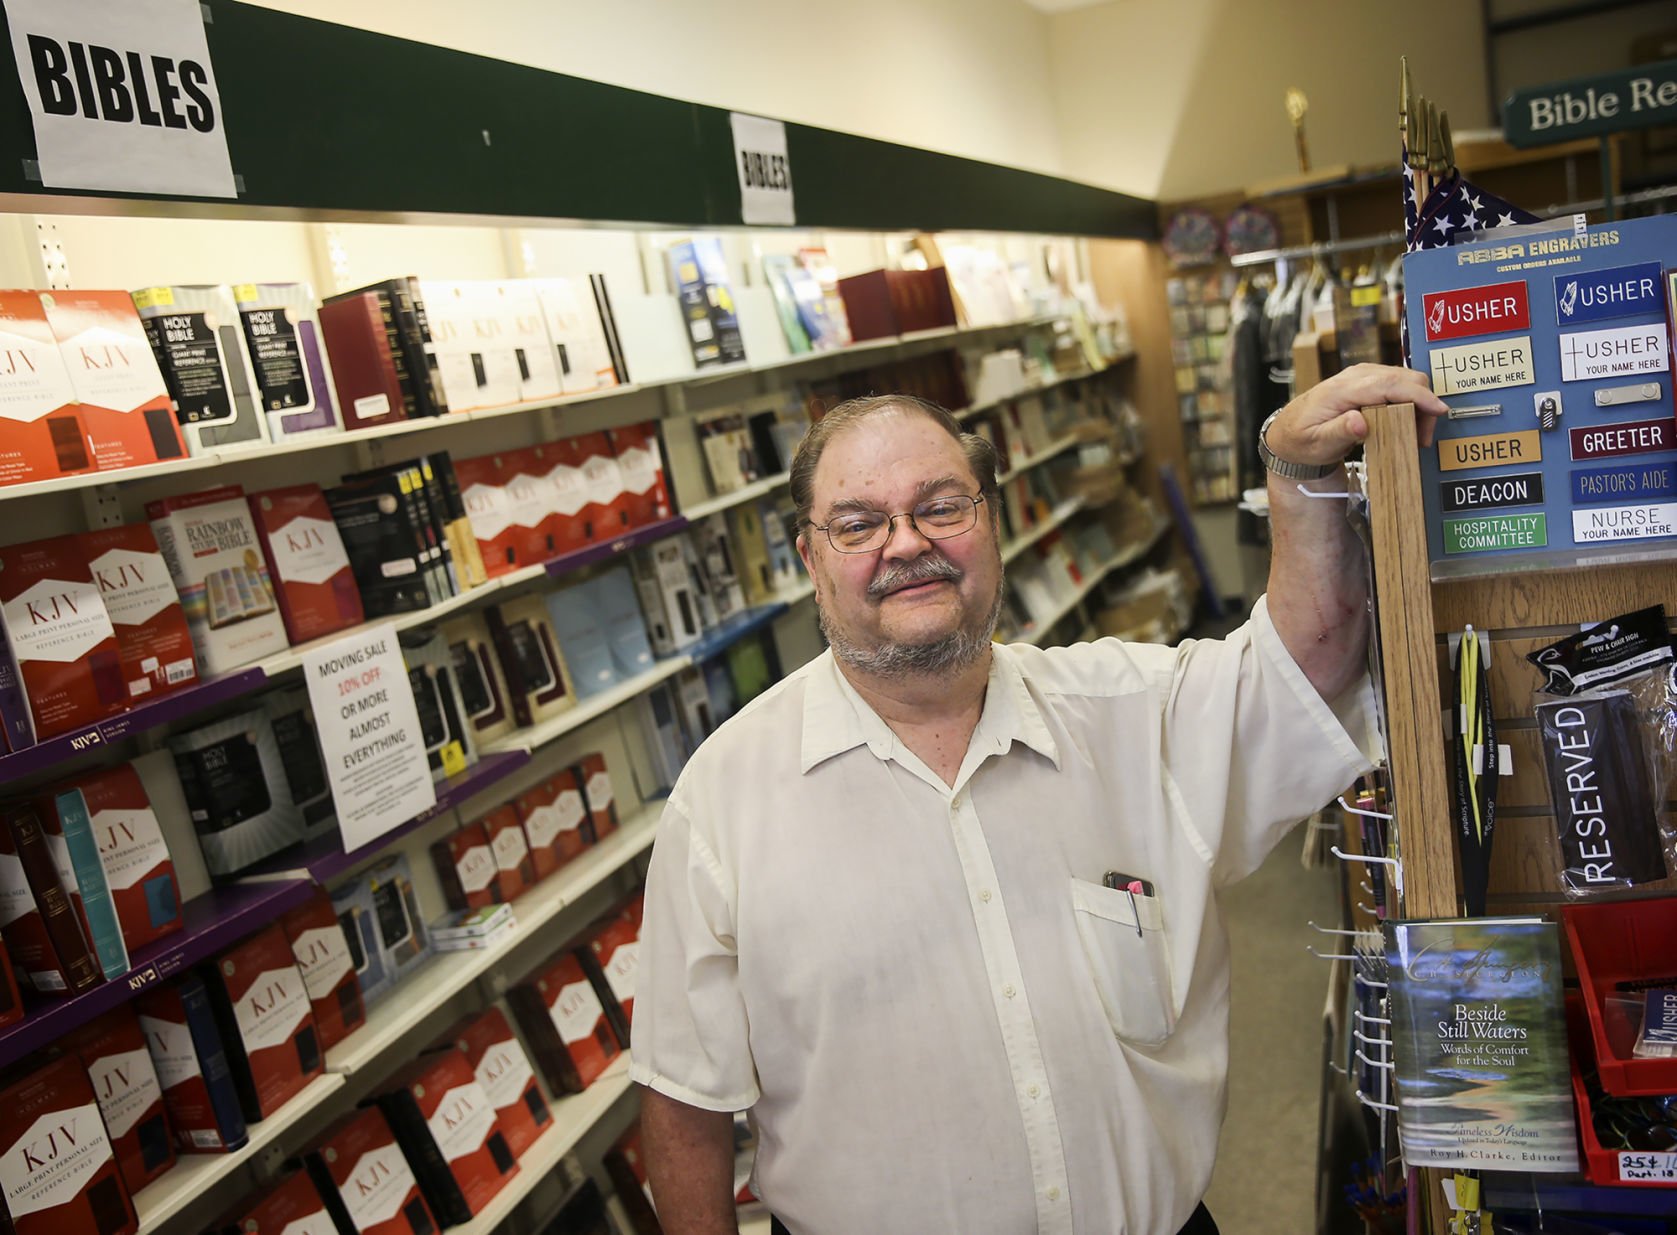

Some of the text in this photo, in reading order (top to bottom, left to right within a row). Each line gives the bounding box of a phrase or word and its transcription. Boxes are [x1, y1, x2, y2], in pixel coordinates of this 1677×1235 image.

[26, 33, 215, 133] BIBLES
[1529, 76, 1677, 131] Bible Re
[741, 150, 788, 191] BIBLES
[1457, 230, 1620, 266] ABBA ENGRAVERS
[1496, 262, 1522, 273] CUSTOM
[1580, 278, 1654, 306] USHER
[162, 316, 192, 330] HOLY
[249, 312, 275, 324] HOLY
[1447, 297, 1518, 324] USHER
[166, 329, 195, 343] BIBLE
[252, 323, 278, 337] BIBLE
[80, 345, 131, 370] KJV
[1586, 335, 1660, 359] USHER
[1454, 348, 1525, 373] USHER
[1586, 358, 1661, 375] YOUR NAME HERE
[1456, 371, 1527, 389] YOUR NAME HERE
[1456, 439, 1522, 463] USHER
[1583, 426, 1663, 453] GREETER
[1454, 480, 1528, 505] DEACON
[1580, 469, 1669, 496] PASTOR'S AIDE
[185, 516, 245, 543] RAINBOW
[1454, 517, 1537, 535] HOSPITALITY
[1592, 508, 1660, 528] NURSE
[218, 531, 253, 551] BIBLE
[286, 527, 325, 553] KJV
[1459, 532, 1534, 549] COMMITTEE
[1583, 524, 1673, 540] YOUR NAME HERE
[96, 562, 145, 593] KJV
[26, 590, 79, 625] KJV
[15, 630, 37, 642] LARGE
[38, 625, 58, 636] PRINT
[59, 619, 90, 631] PERSONAL
[35, 636, 75, 650] REFERENCE
[319, 640, 388, 678] MOVING SALE
[337, 667, 382, 697] 10% OFF
[340, 688, 389, 720] OR MORE
[349, 712, 392, 742] ALMOST
[70, 734, 90, 750] KJV
[343, 729, 407, 769] EVERYTHING
[1555, 707, 1616, 883] RESERVED
[128, 974, 148, 990] KJV
[251, 975, 288, 1018] KJV
[1455, 1003, 1507, 1021] Beside
[1662, 994, 1677, 1030] USHER
[1437, 1021, 1527, 1039] Still Waters
[1441, 1043, 1529, 1055] Words of Comfort
[1456, 1054, 1516, 1066] for the Soul
[441, 1096, 474, 1130] KJV
[1447, 1122, 1540, 1138] Timeless Wisdom
[21, 1117, 79, 1175] KJV
[1430, 1148, 1561, 1161] Roy H. Clarke, Editor
[9, 1180, 32, 1199] LARGE
[34, 1167, 55, 1184] PRINT
[55, 1145, 89, 1171] PERSONAL
[31, 1159, 94, 1200] REFERENCE BIBLE
[355, 1160, 391, 1197] KJV
